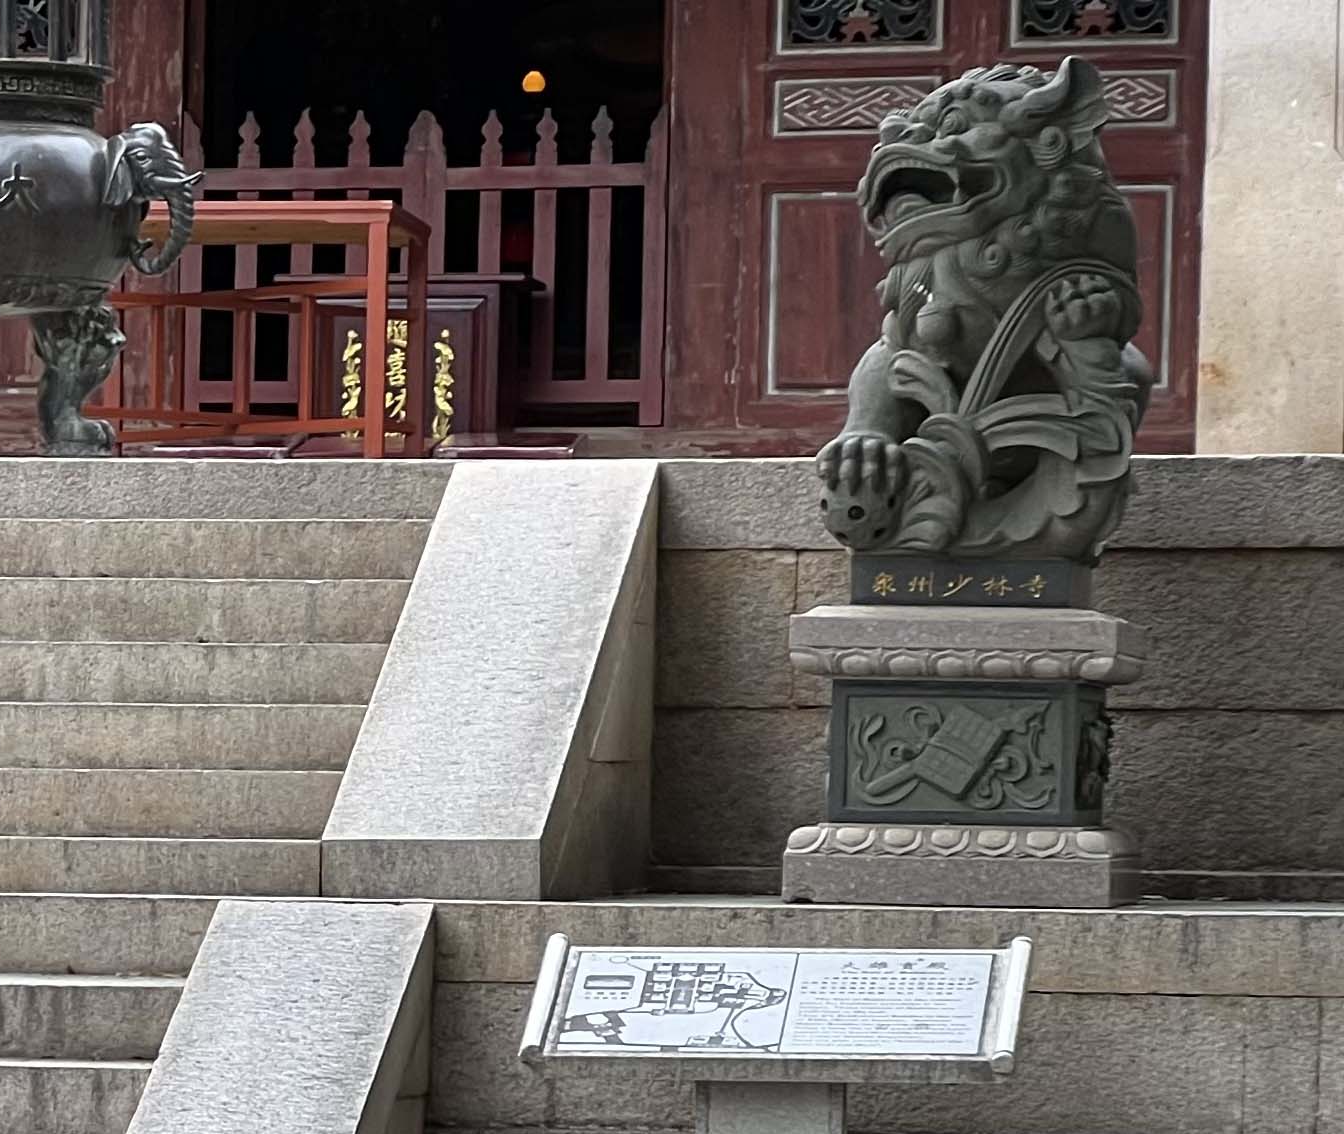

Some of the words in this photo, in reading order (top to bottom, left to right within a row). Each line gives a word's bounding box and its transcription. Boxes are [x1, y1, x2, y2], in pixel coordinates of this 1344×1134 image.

[384, 319, 408, 437] 隨喜功
[871, 571, 1049, 598] 泉州少林寺
